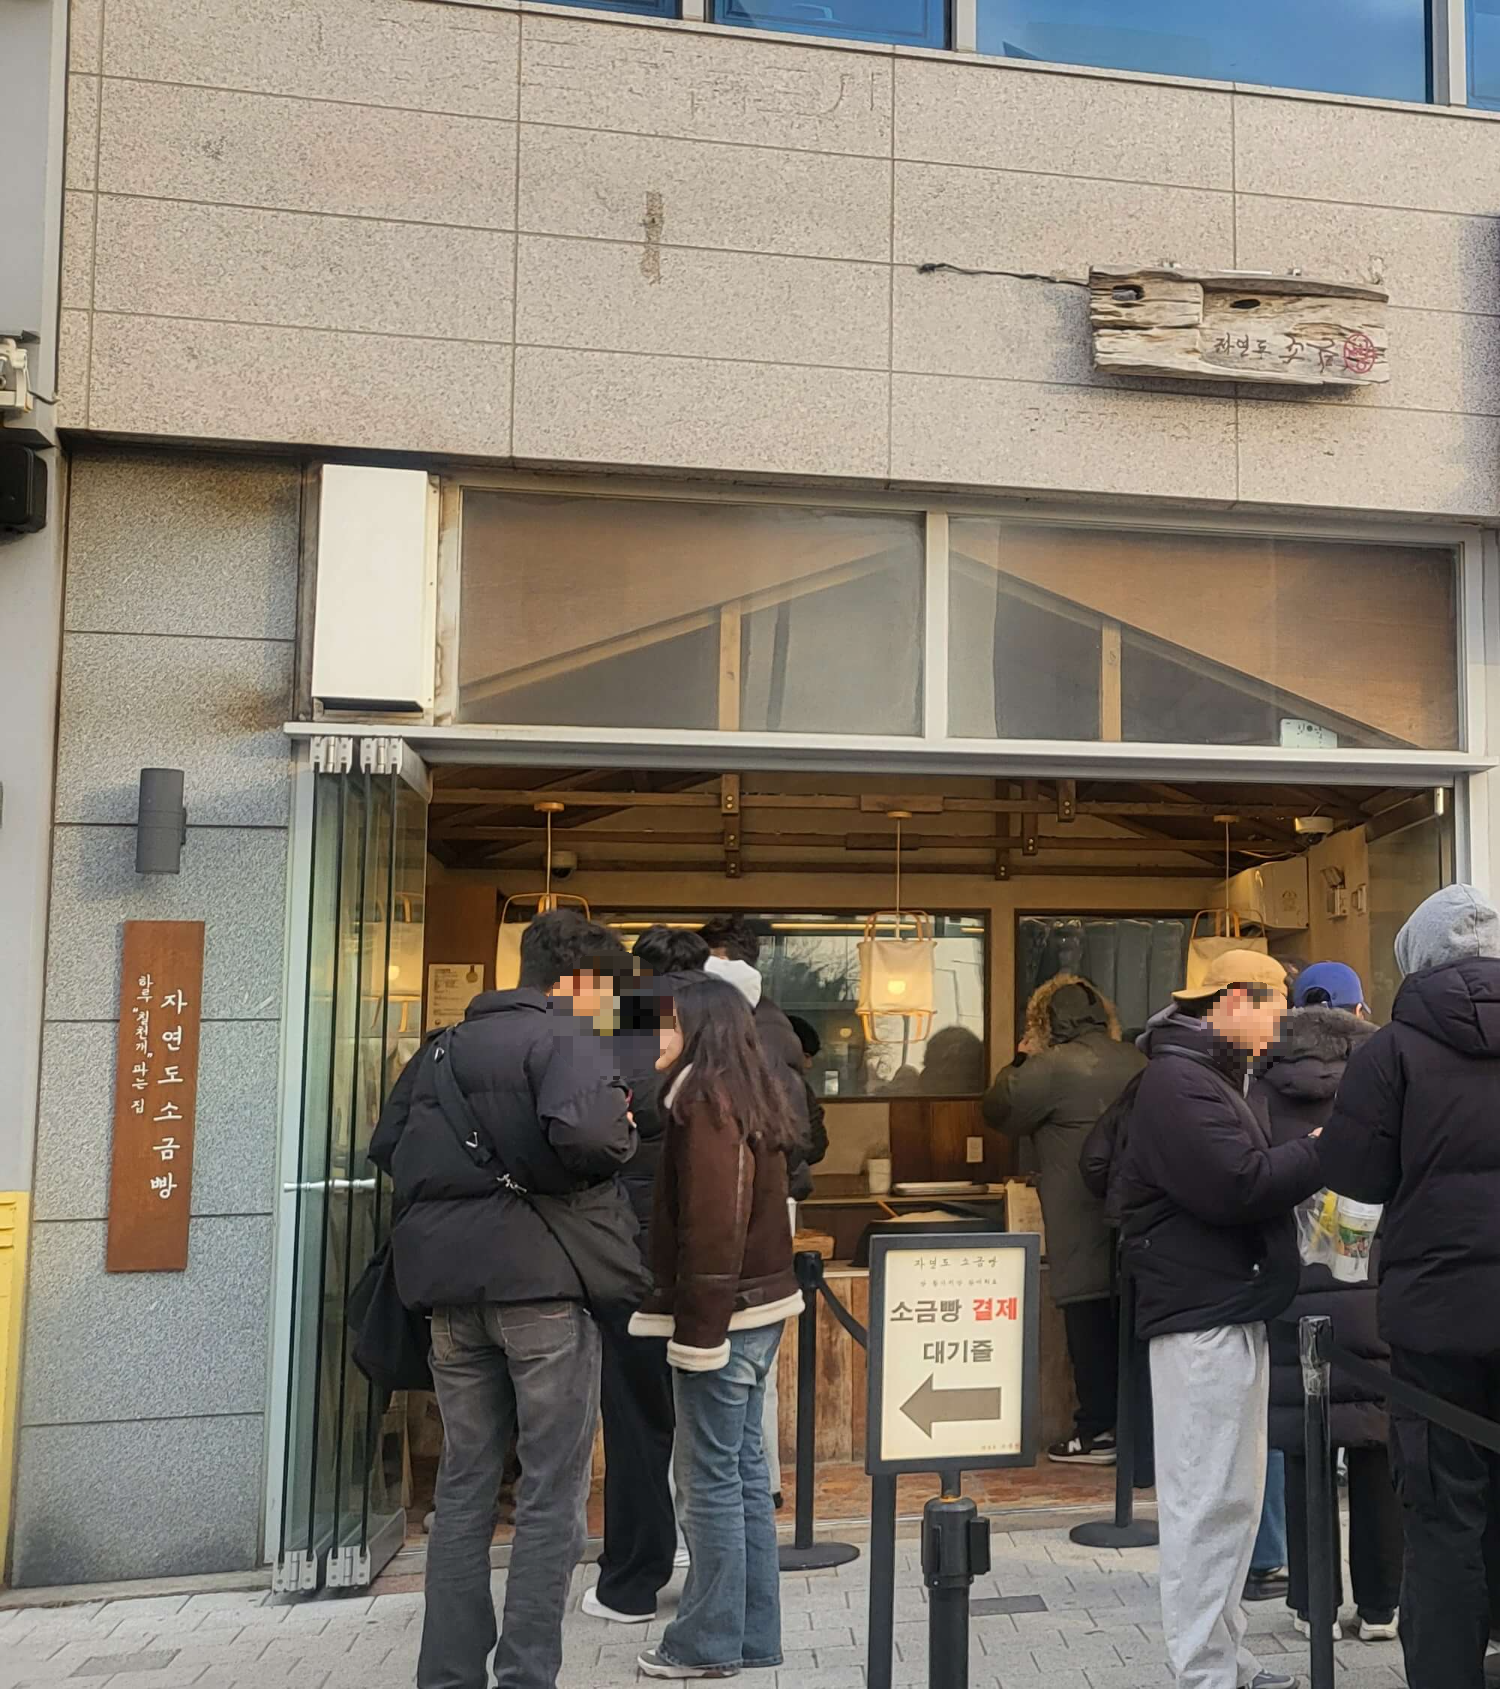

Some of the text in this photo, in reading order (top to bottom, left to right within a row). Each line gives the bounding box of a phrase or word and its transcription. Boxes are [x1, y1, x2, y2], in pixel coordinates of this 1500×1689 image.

[136, 973, 154, 1003] 하루
[131, 1061, 149, 1090] 파는
[130, 1097, 145, 1114] 집
[890, 1296, 1018, 1323] 소금빵 결제
[923, 1339, 994, 1364] 대기줄
